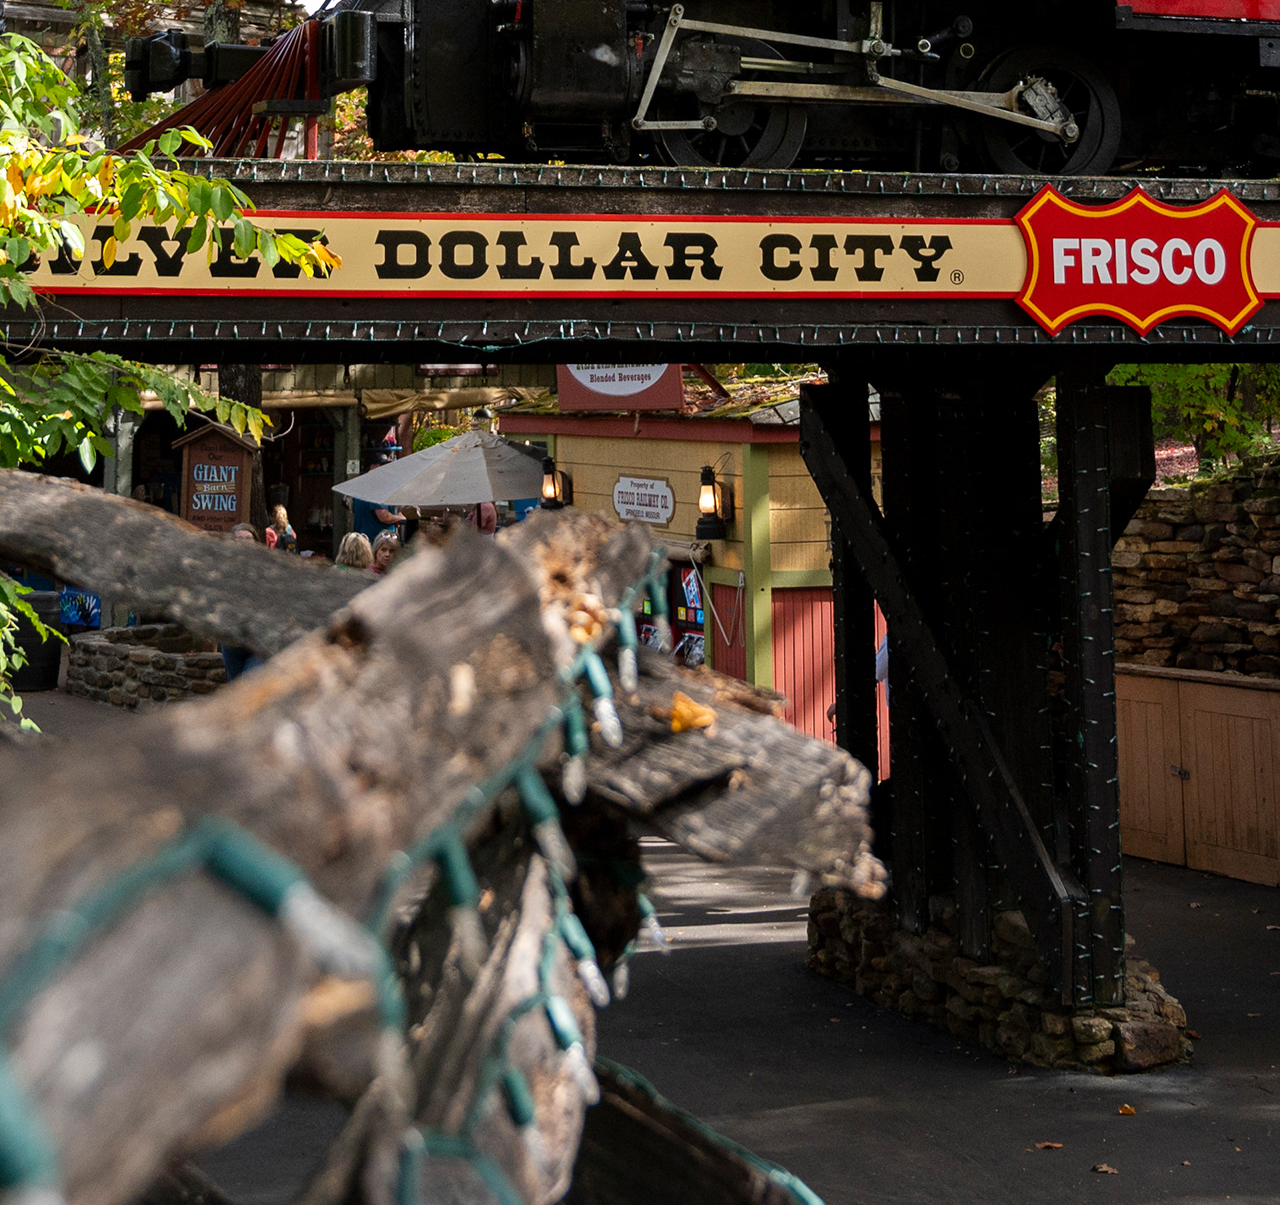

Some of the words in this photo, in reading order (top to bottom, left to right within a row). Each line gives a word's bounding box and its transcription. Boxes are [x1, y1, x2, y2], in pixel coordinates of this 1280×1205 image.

[374, 229, 723, 281] DOLLAR
[1053, 238, 1226, 285] FRISCO
[589, 373, 616, 383] Blended
[618, 372, 652, 384] Beverages
[193, 463, 239, 483] GIANT
[203, 484, 228, 492] Barn
[630, 480, 649, 490] Property
[192, 493, 237, 512] SWING
[618, 491, 635, 505] FRISCO
[636, 492, 659, 508] RAILWAY
